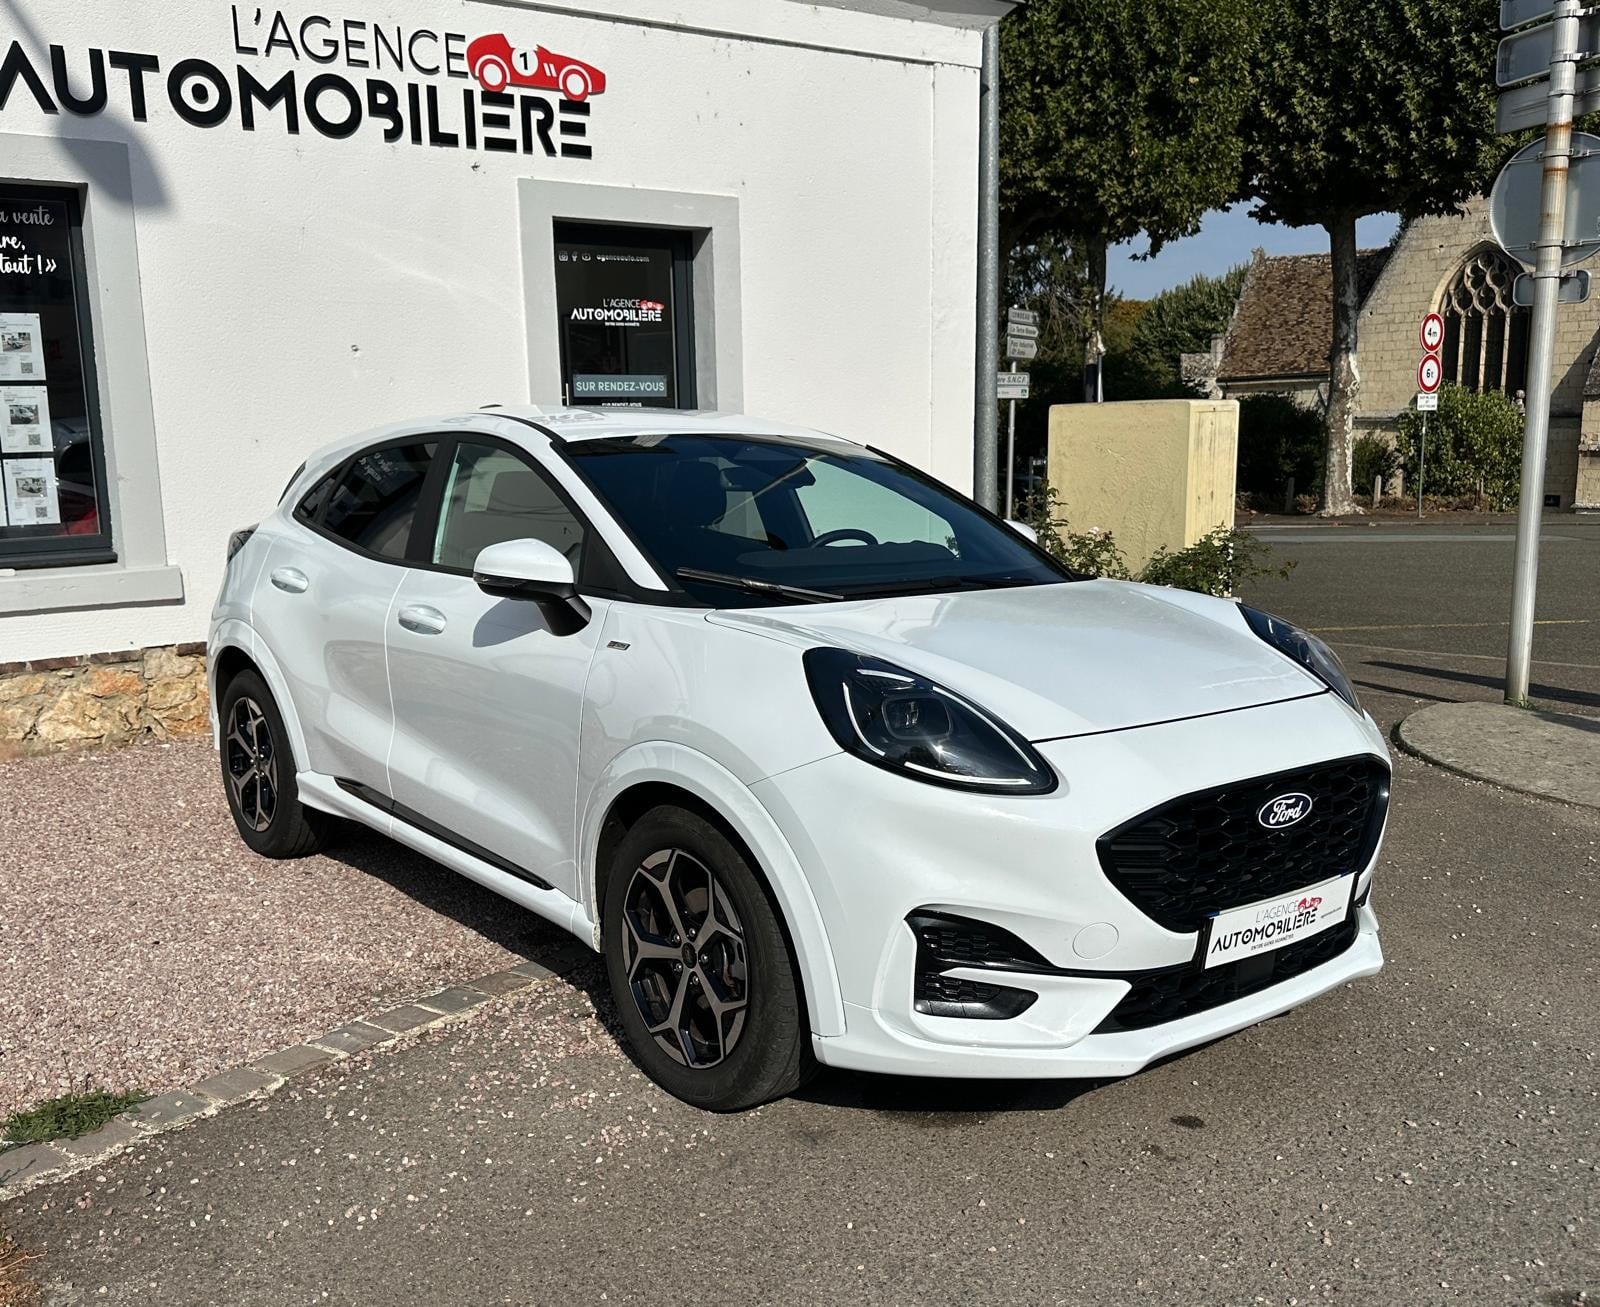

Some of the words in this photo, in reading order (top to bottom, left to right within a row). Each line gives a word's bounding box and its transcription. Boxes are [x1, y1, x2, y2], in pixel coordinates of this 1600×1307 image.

[231, 4, 471, 79] L'AGENCE
[12, 205, 54, 226] vente
[602, 298, 641, 309] L'AGENCE
[576, 381, 596, 391] SUR
[598, 381, 665, 391] RENDEZ-VOUS
[1269, 797, 1304, 825] Ford
[1255, 900, 1299, 924] L'AGENCE
